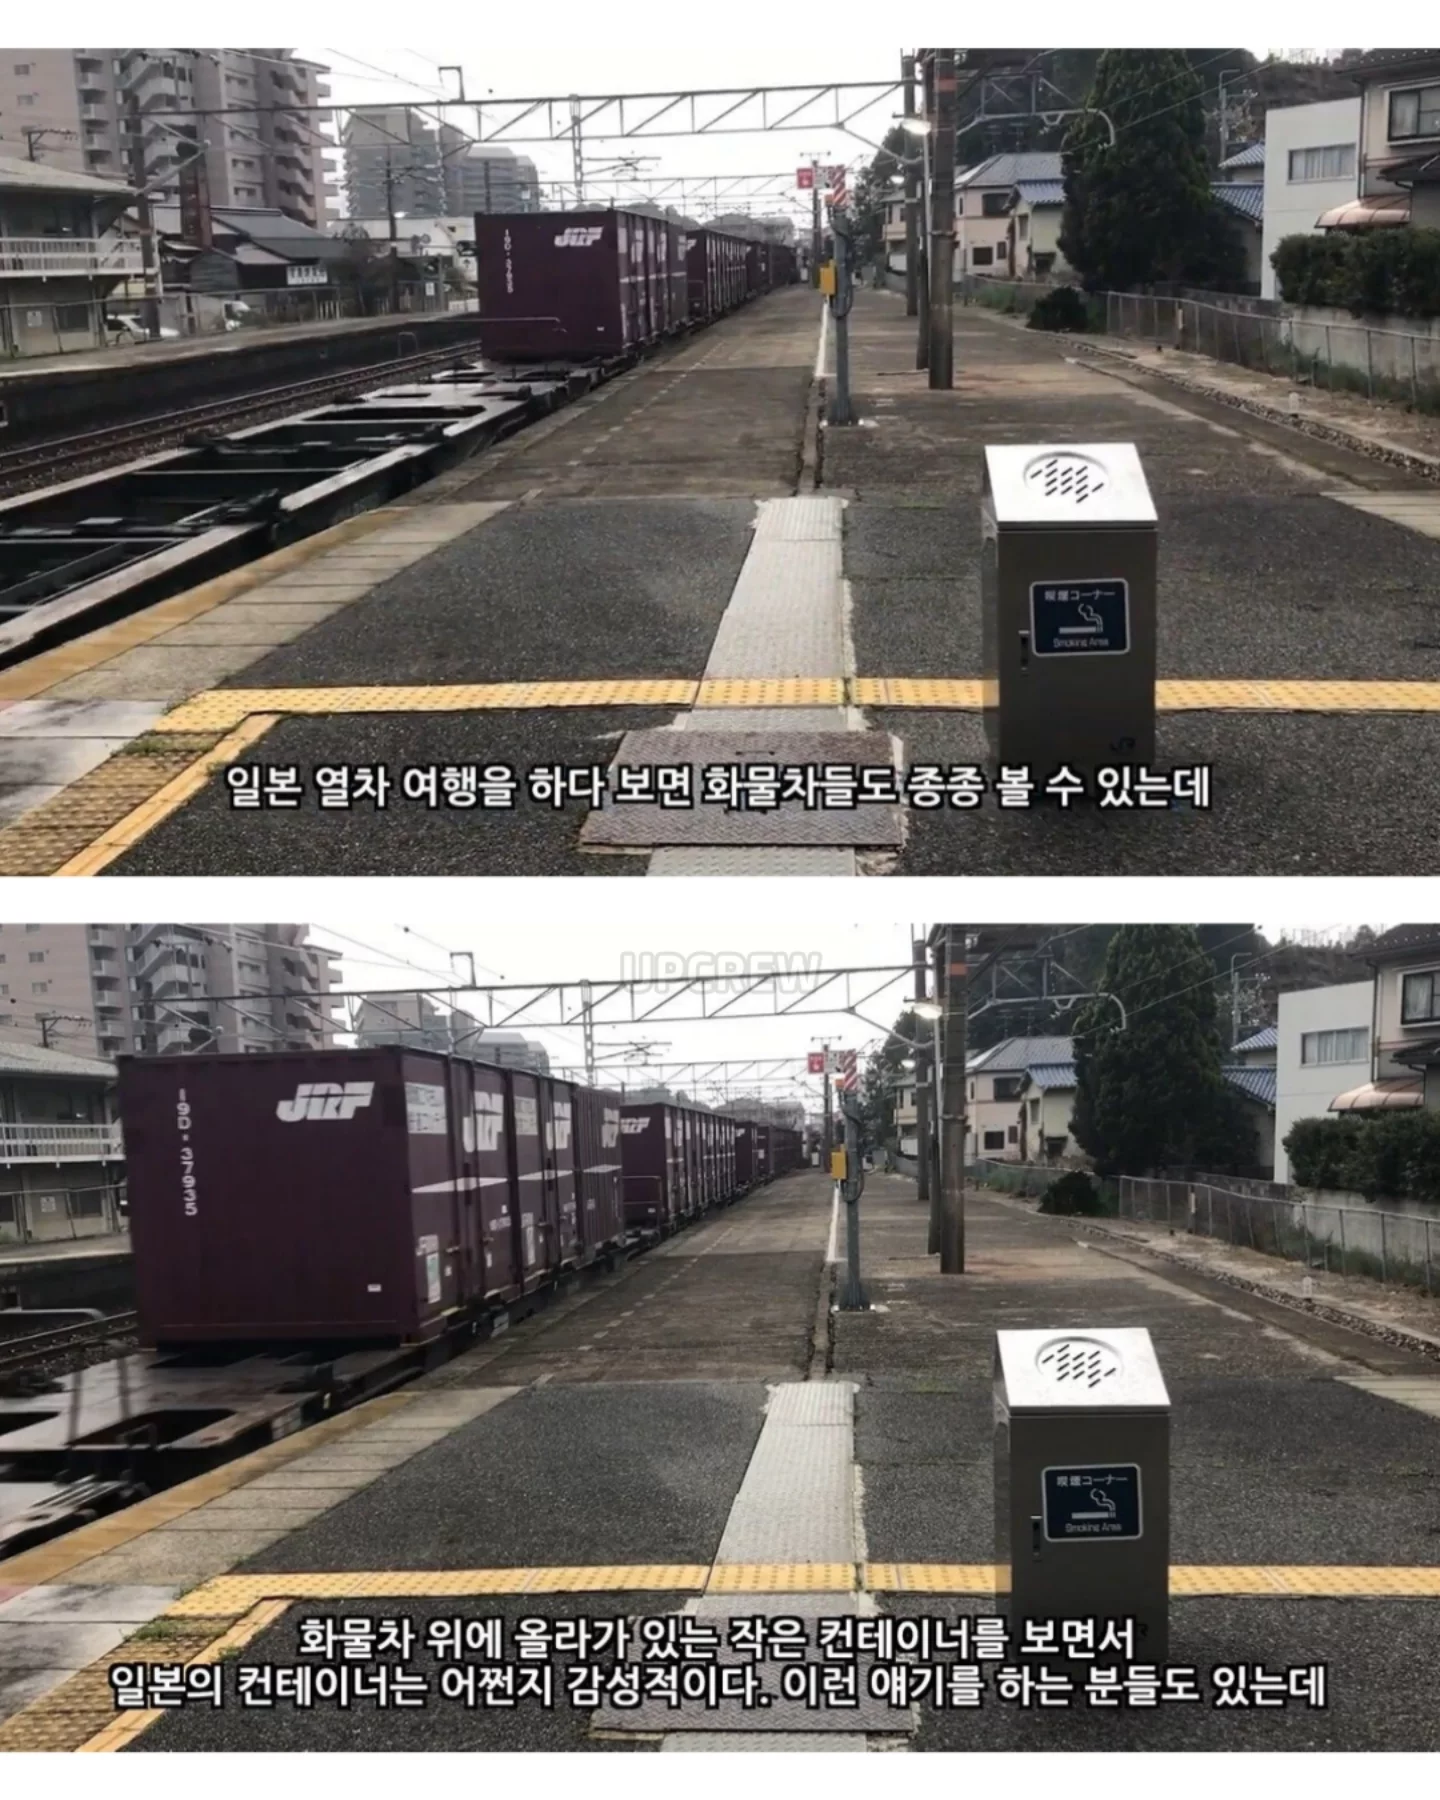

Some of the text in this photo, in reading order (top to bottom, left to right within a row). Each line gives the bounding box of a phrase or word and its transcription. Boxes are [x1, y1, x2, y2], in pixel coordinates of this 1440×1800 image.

[1053, 636, 1109, 649] Smoking Area
[276, 1081, 375, 1122] JRF
[1065, 1522, 1122, 1533] Smoking Area
